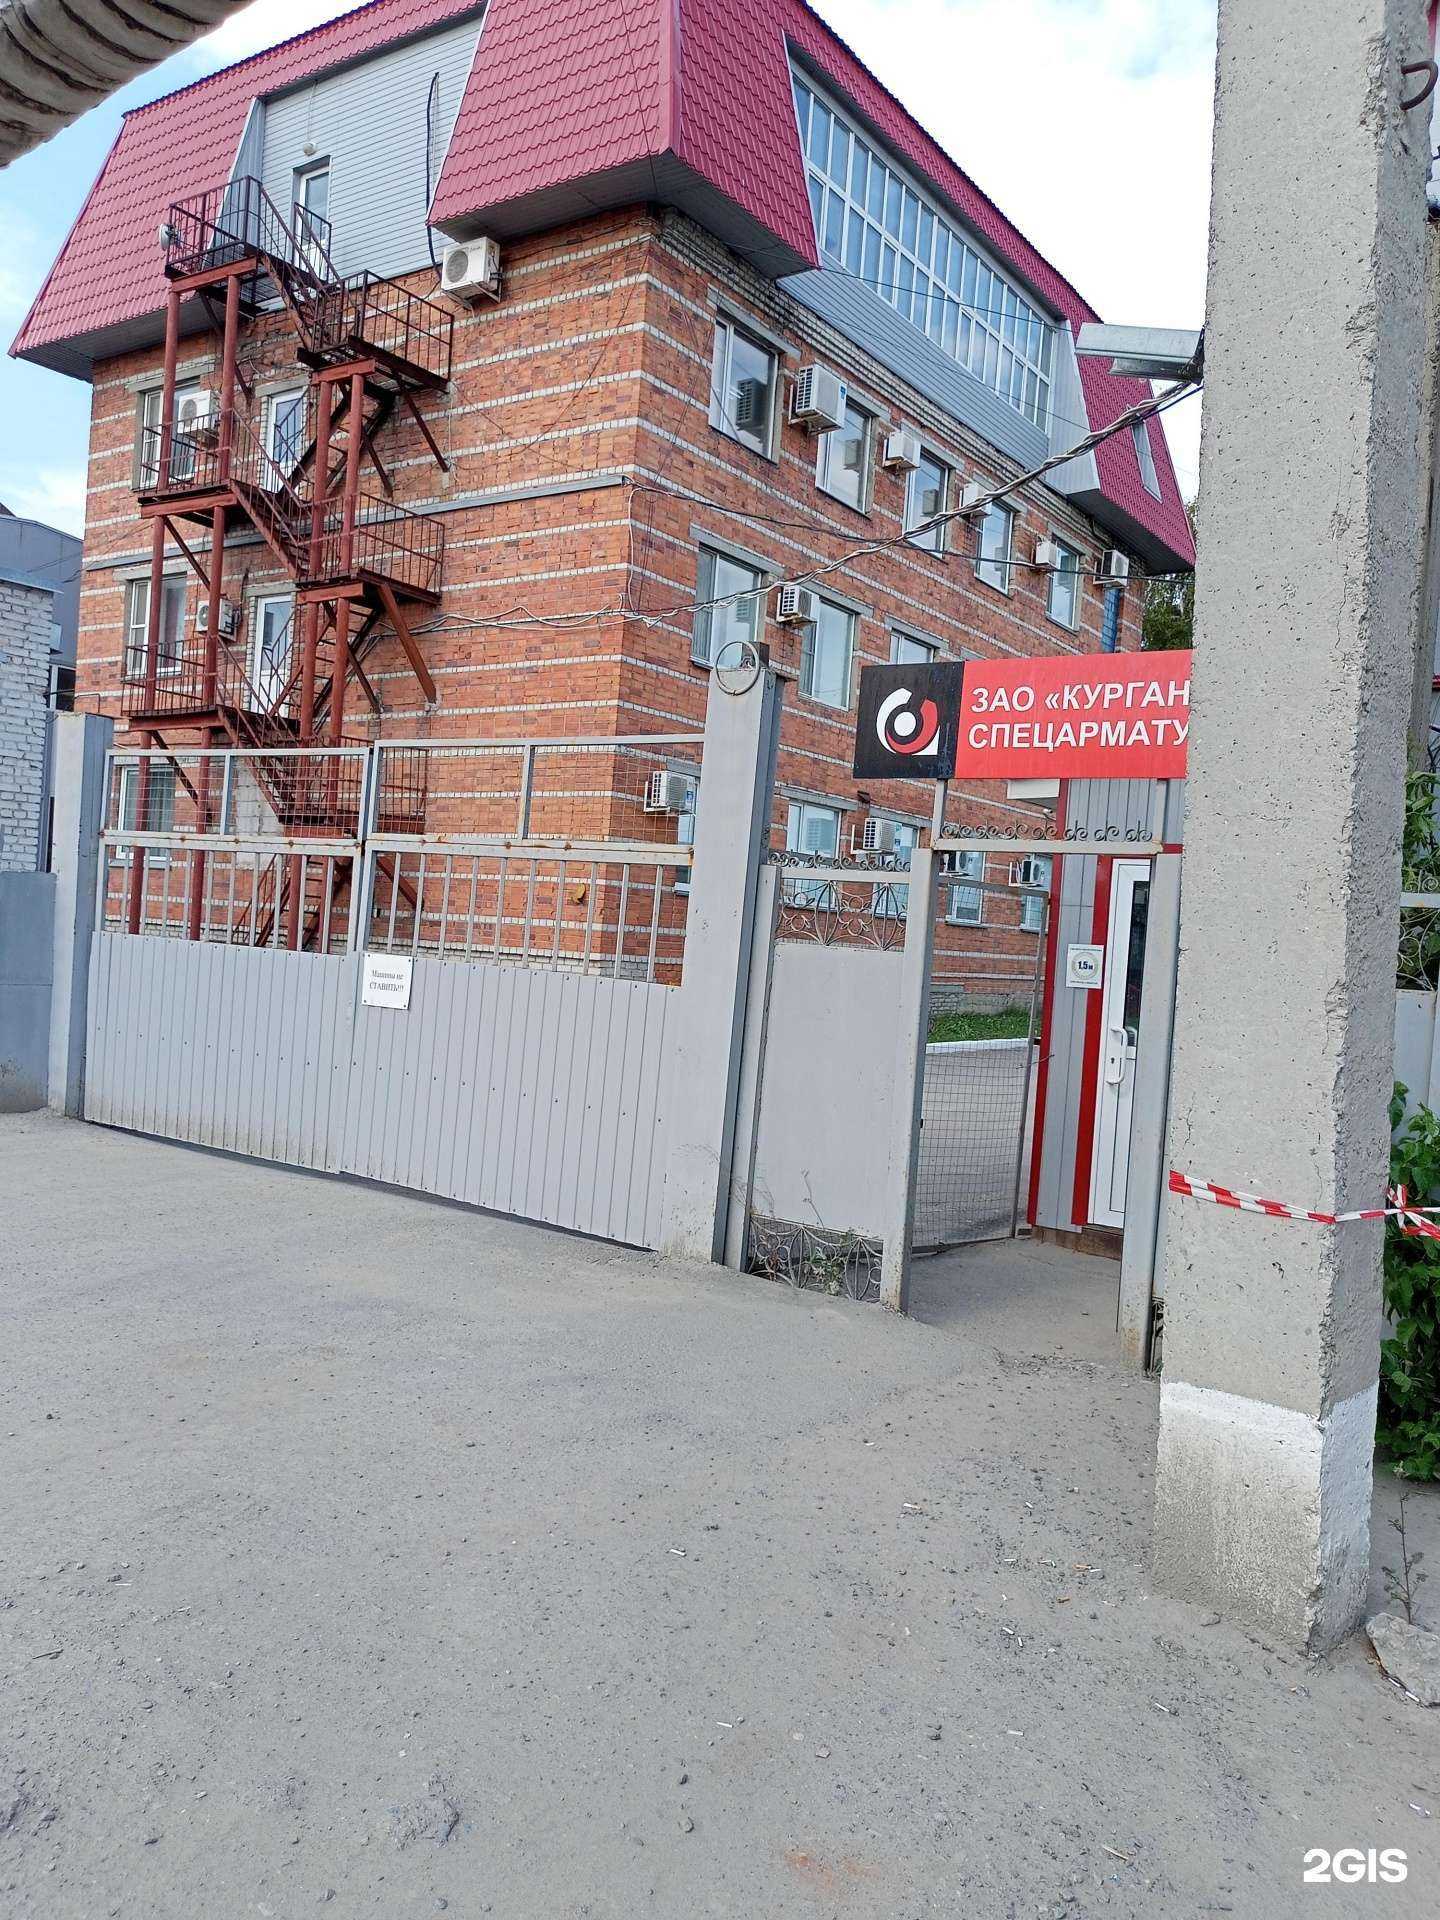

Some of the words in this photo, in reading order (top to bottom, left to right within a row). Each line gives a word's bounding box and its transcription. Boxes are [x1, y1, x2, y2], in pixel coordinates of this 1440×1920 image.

[970, 686, 1035, 713] ЗАО
[1045, 680, 1190, 711] «КУРГАН
[968, 719, 1189, 752] СПЕЦАРМАТУ
